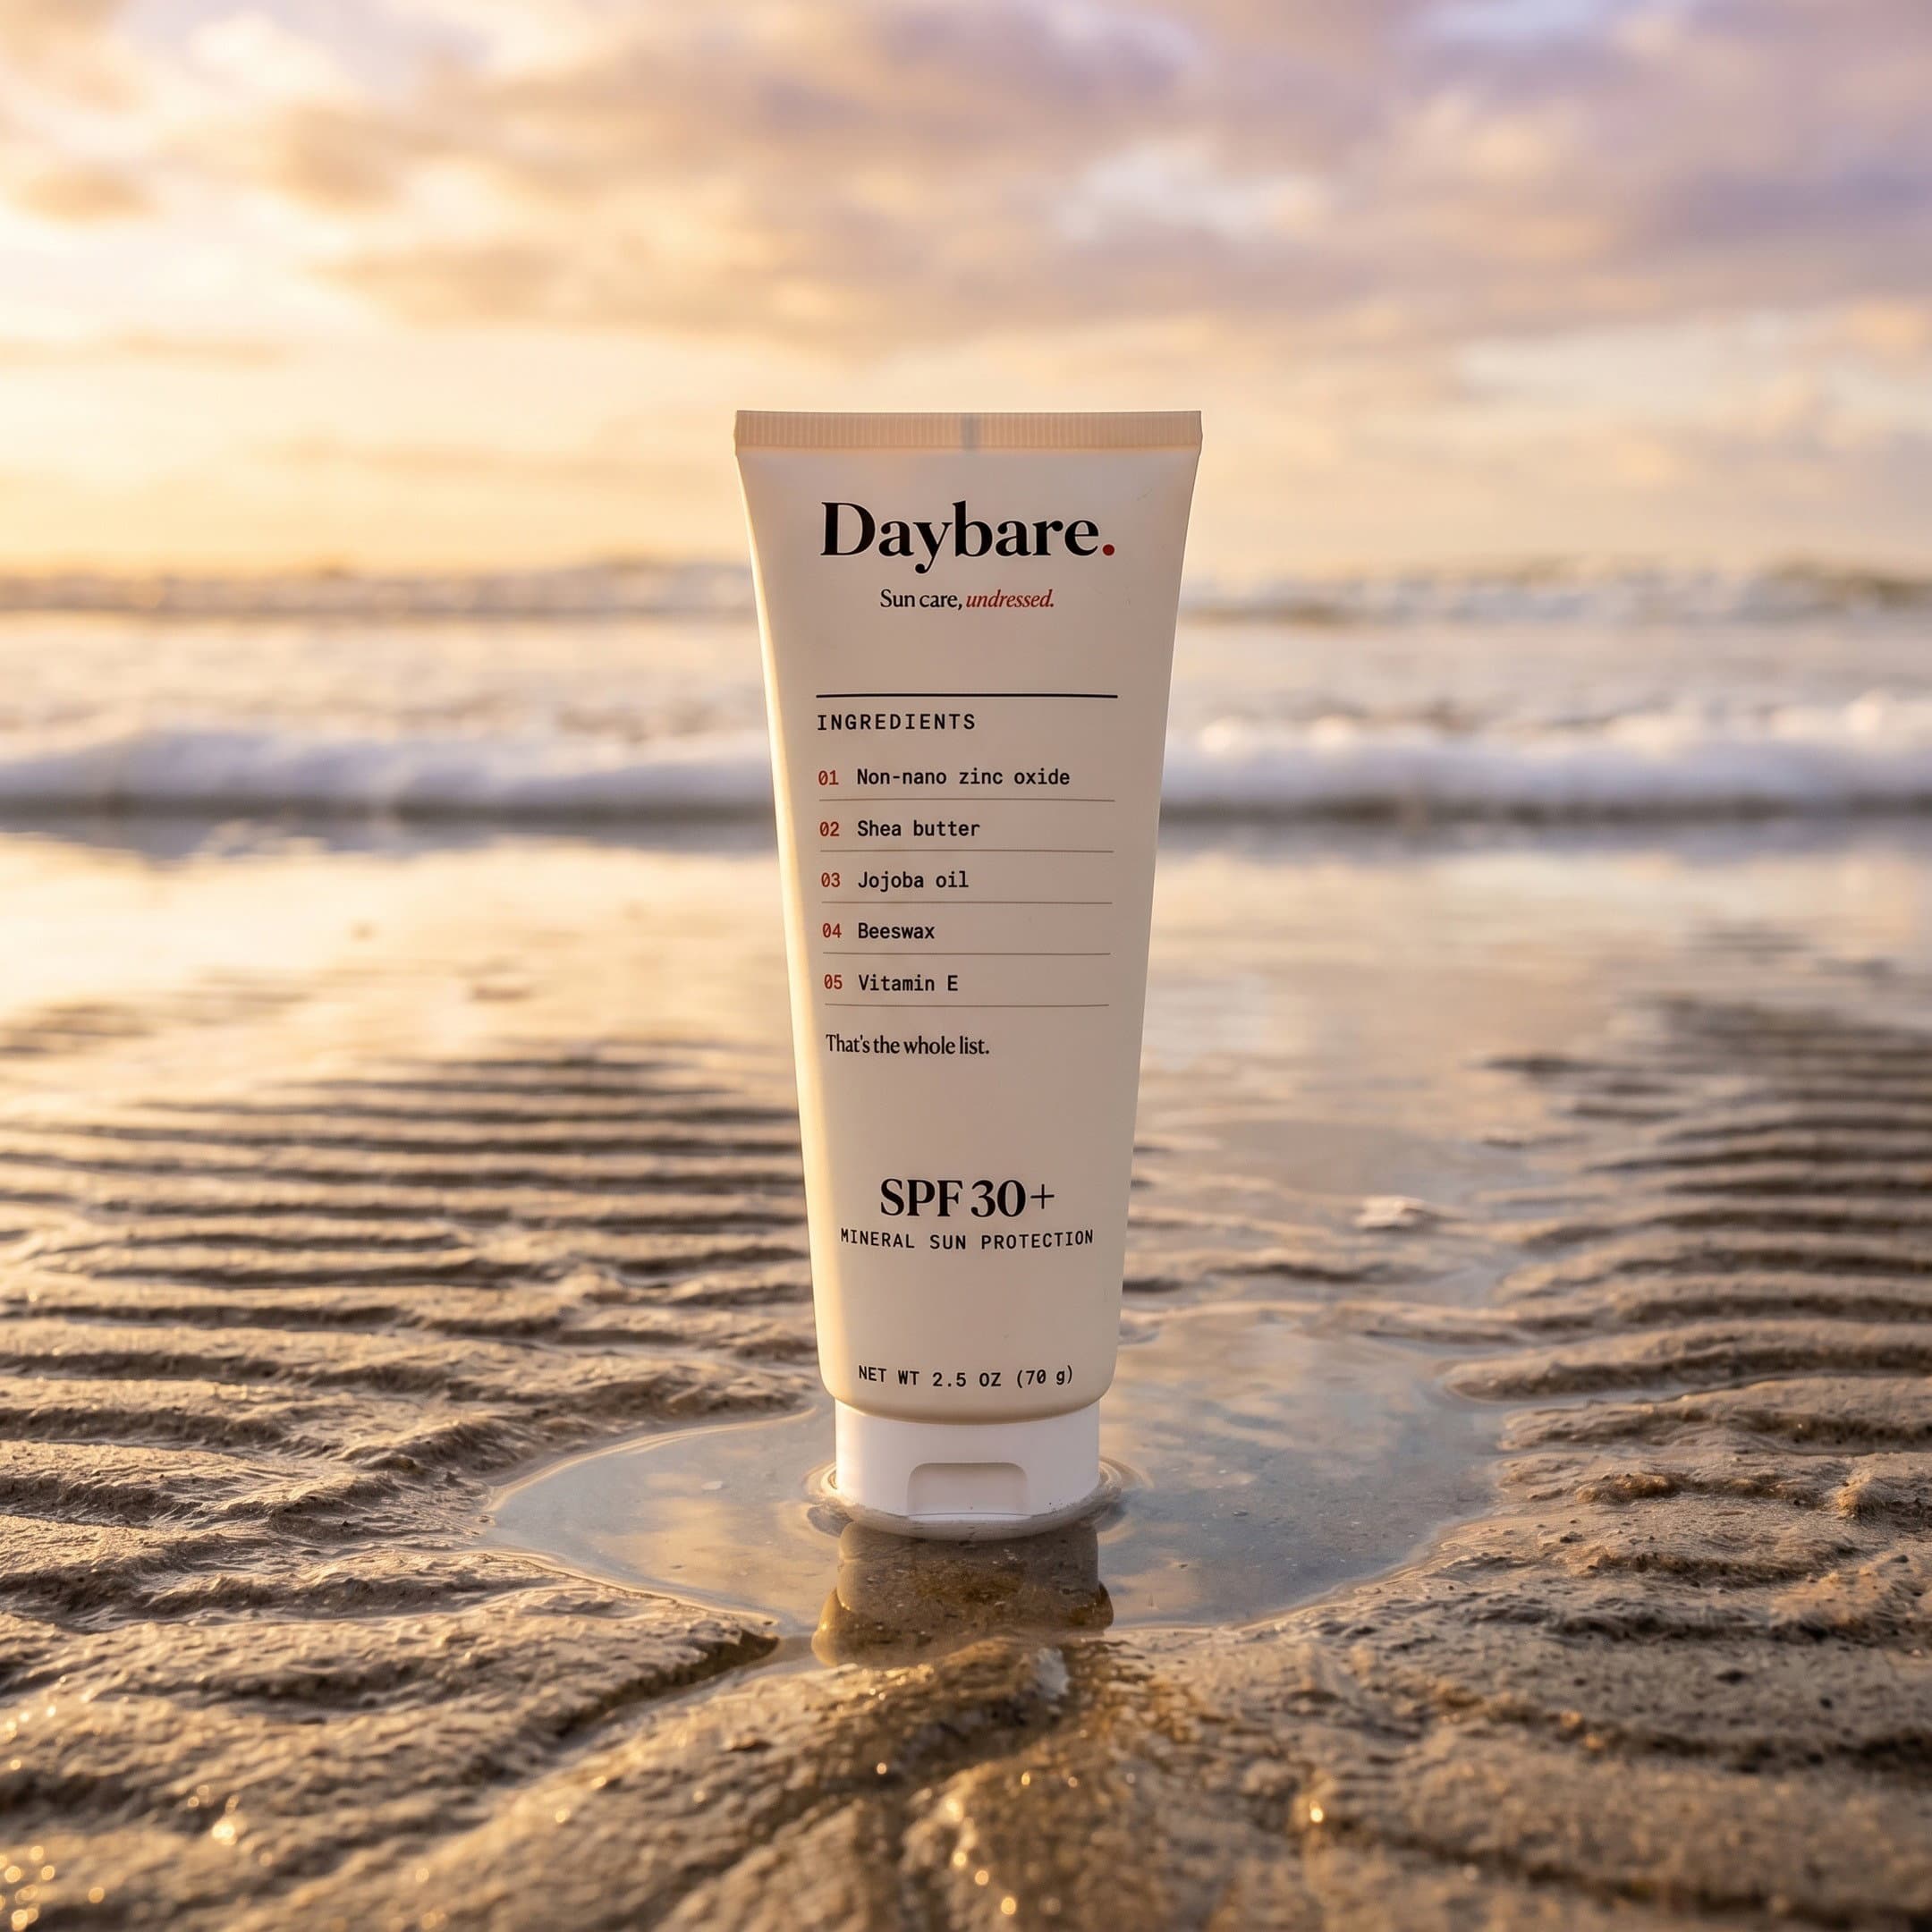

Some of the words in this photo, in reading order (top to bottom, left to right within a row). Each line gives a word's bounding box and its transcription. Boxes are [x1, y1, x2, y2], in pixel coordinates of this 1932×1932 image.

[820, 499, 1115, 574] Daybare.
[879, 589, 916, 608] Sun
[919, 594, 963, 611] care,
[965, 588, 1055, 609] undressed.
[817, 713, 976, 731] INGREDIENTS
[818, 769, 839, 786] 01
[857, 767, 947, 785] Non-nano
[959, 767, 1003, 785] zinc
[1013, 767, 1071, 785] oxide
[819, 820, 840, 837] 02
[857, 819, 902, 837] Shea
[912, 818, 981, 837] butter
[820, 871, 841, 888] 03
[858, 869, 924, 893] Jojoba
[935, 870, 970, 888] oil
[822, 922, 843, 939] 04
[858, 921, 936, 940] Beeswax
[824, 973, 843, 990] 05
[858, 973, 936, 992] Vitamin
[947, 974, 959, 992] E
[825, 1033, 871, 1054] That's
[872, 1034, 901, 1055] the
[902, 1035, 956, 1055] whole
[959, 1035, 990, 1055] list.
[880, 1178, 963, 1217] SPF
[970, 1179, 1055, 1218] 30+
[840, 1227, 915, 1249] MINERAL
[929, 1233, 966, 1250] SUN
[981, 1228, 1094, 1250] PROTECTION
[858, 1364, 887, 1383] NET
[897, 1369, 920, 1386] WT
[932, 1371, 967, 1387] 2.5
[979, 1371, 1002, 1387] OZ
[1016, 1368, 1046, 1389] (70
[1055, 1364, 1073, 1385] g)
